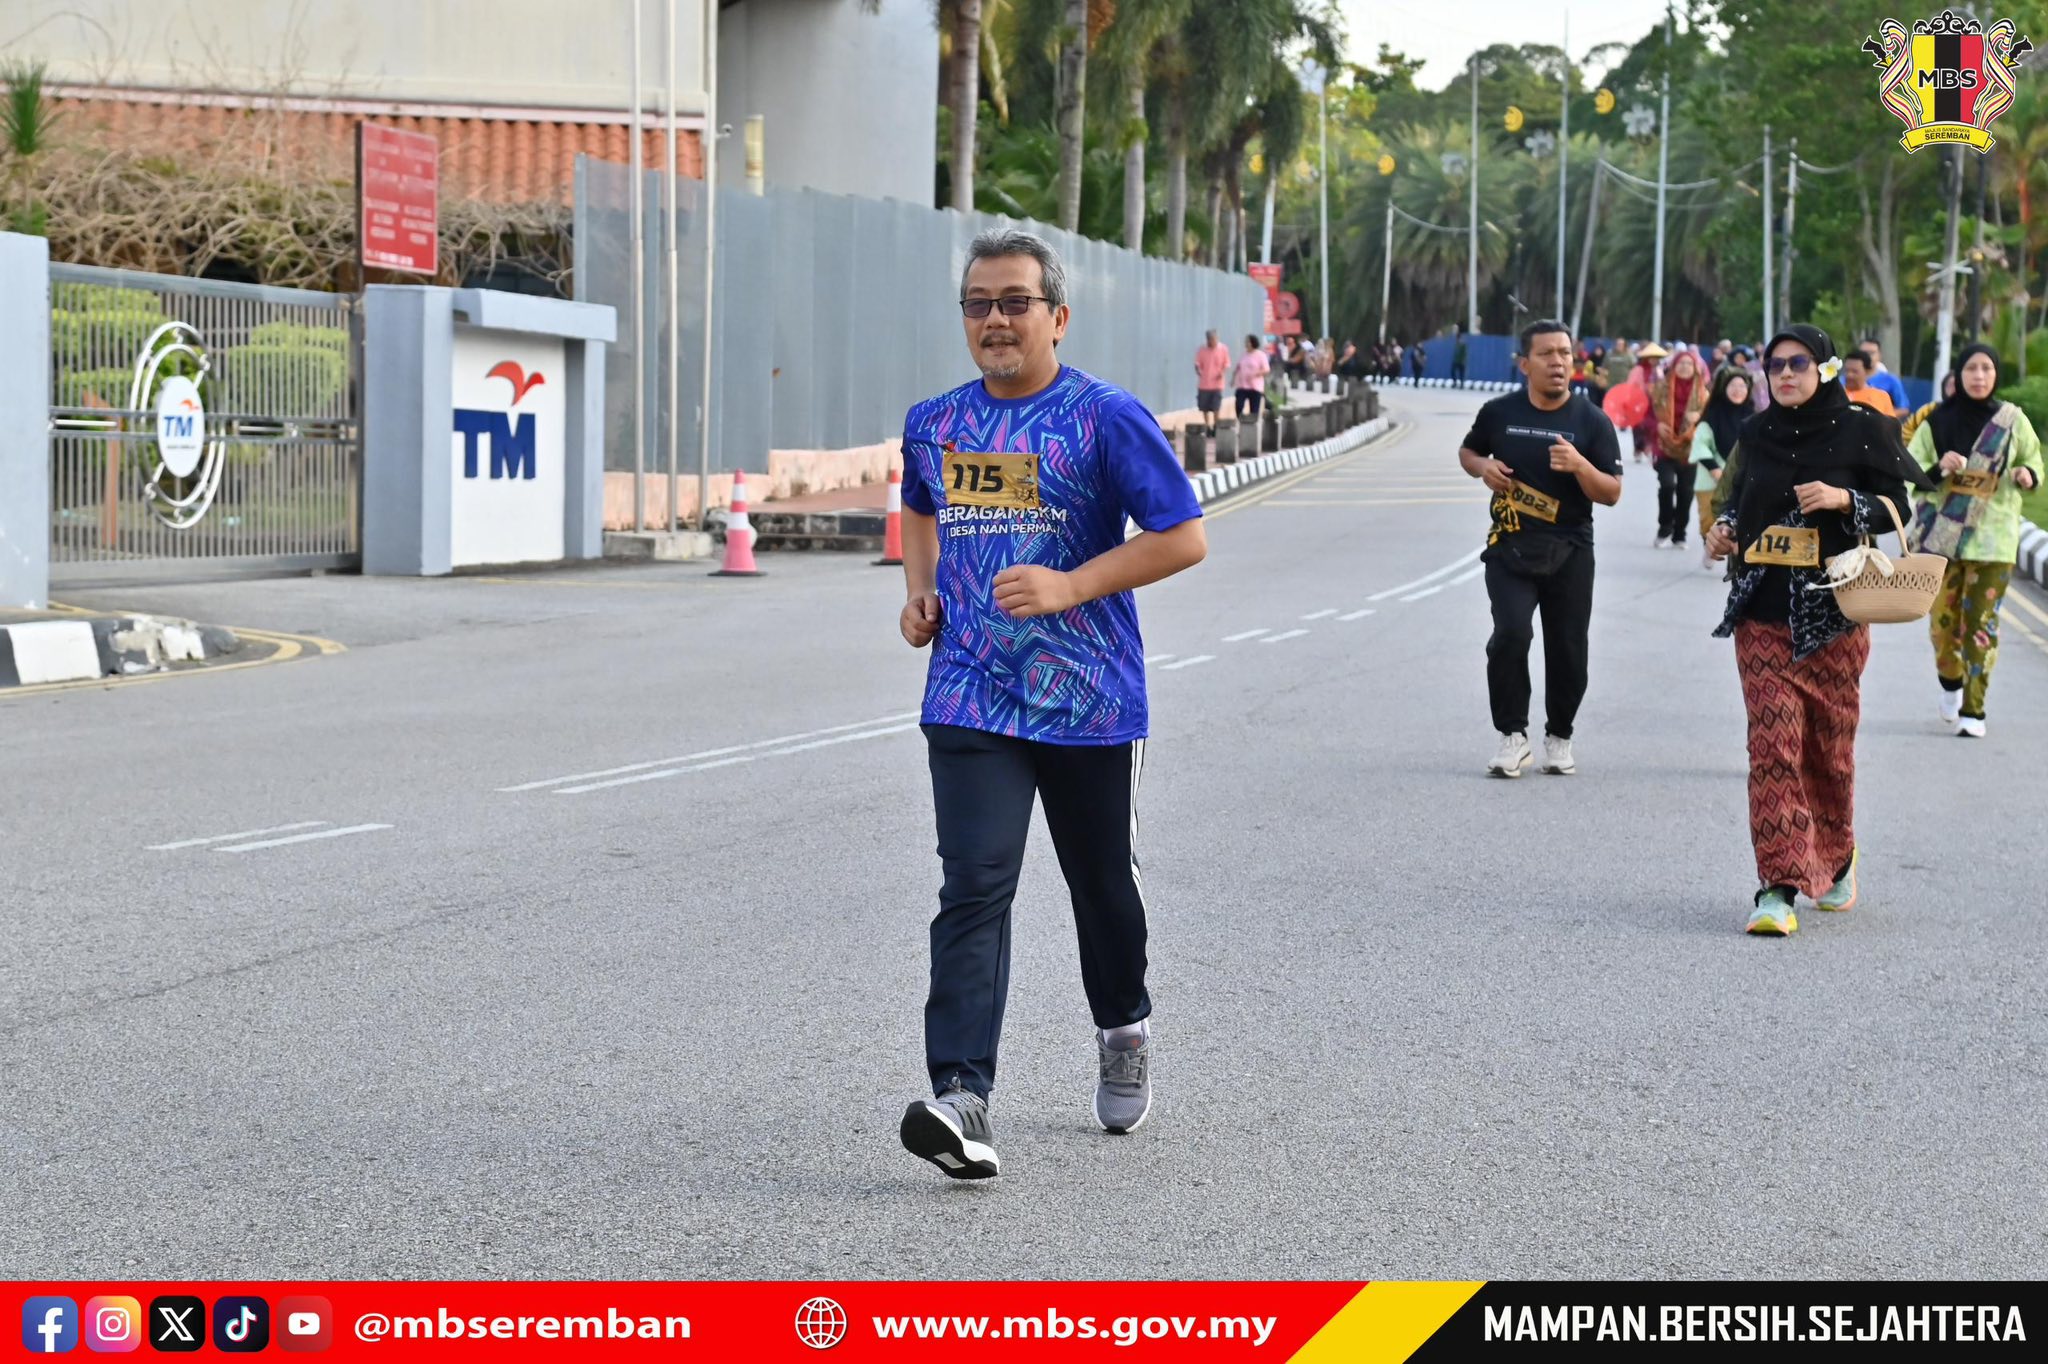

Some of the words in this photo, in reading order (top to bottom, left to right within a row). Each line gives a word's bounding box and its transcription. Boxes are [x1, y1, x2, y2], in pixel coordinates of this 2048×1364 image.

[164, 416, 193, 437] TM
[453, 408, 536, 480] TM
[952, 463, 1003, 493] 115
[939, 506, 1024, 524] BERAGAM
[980, 524, 1008, 534] NAN
[1756, 534, 1791, 554] 114
